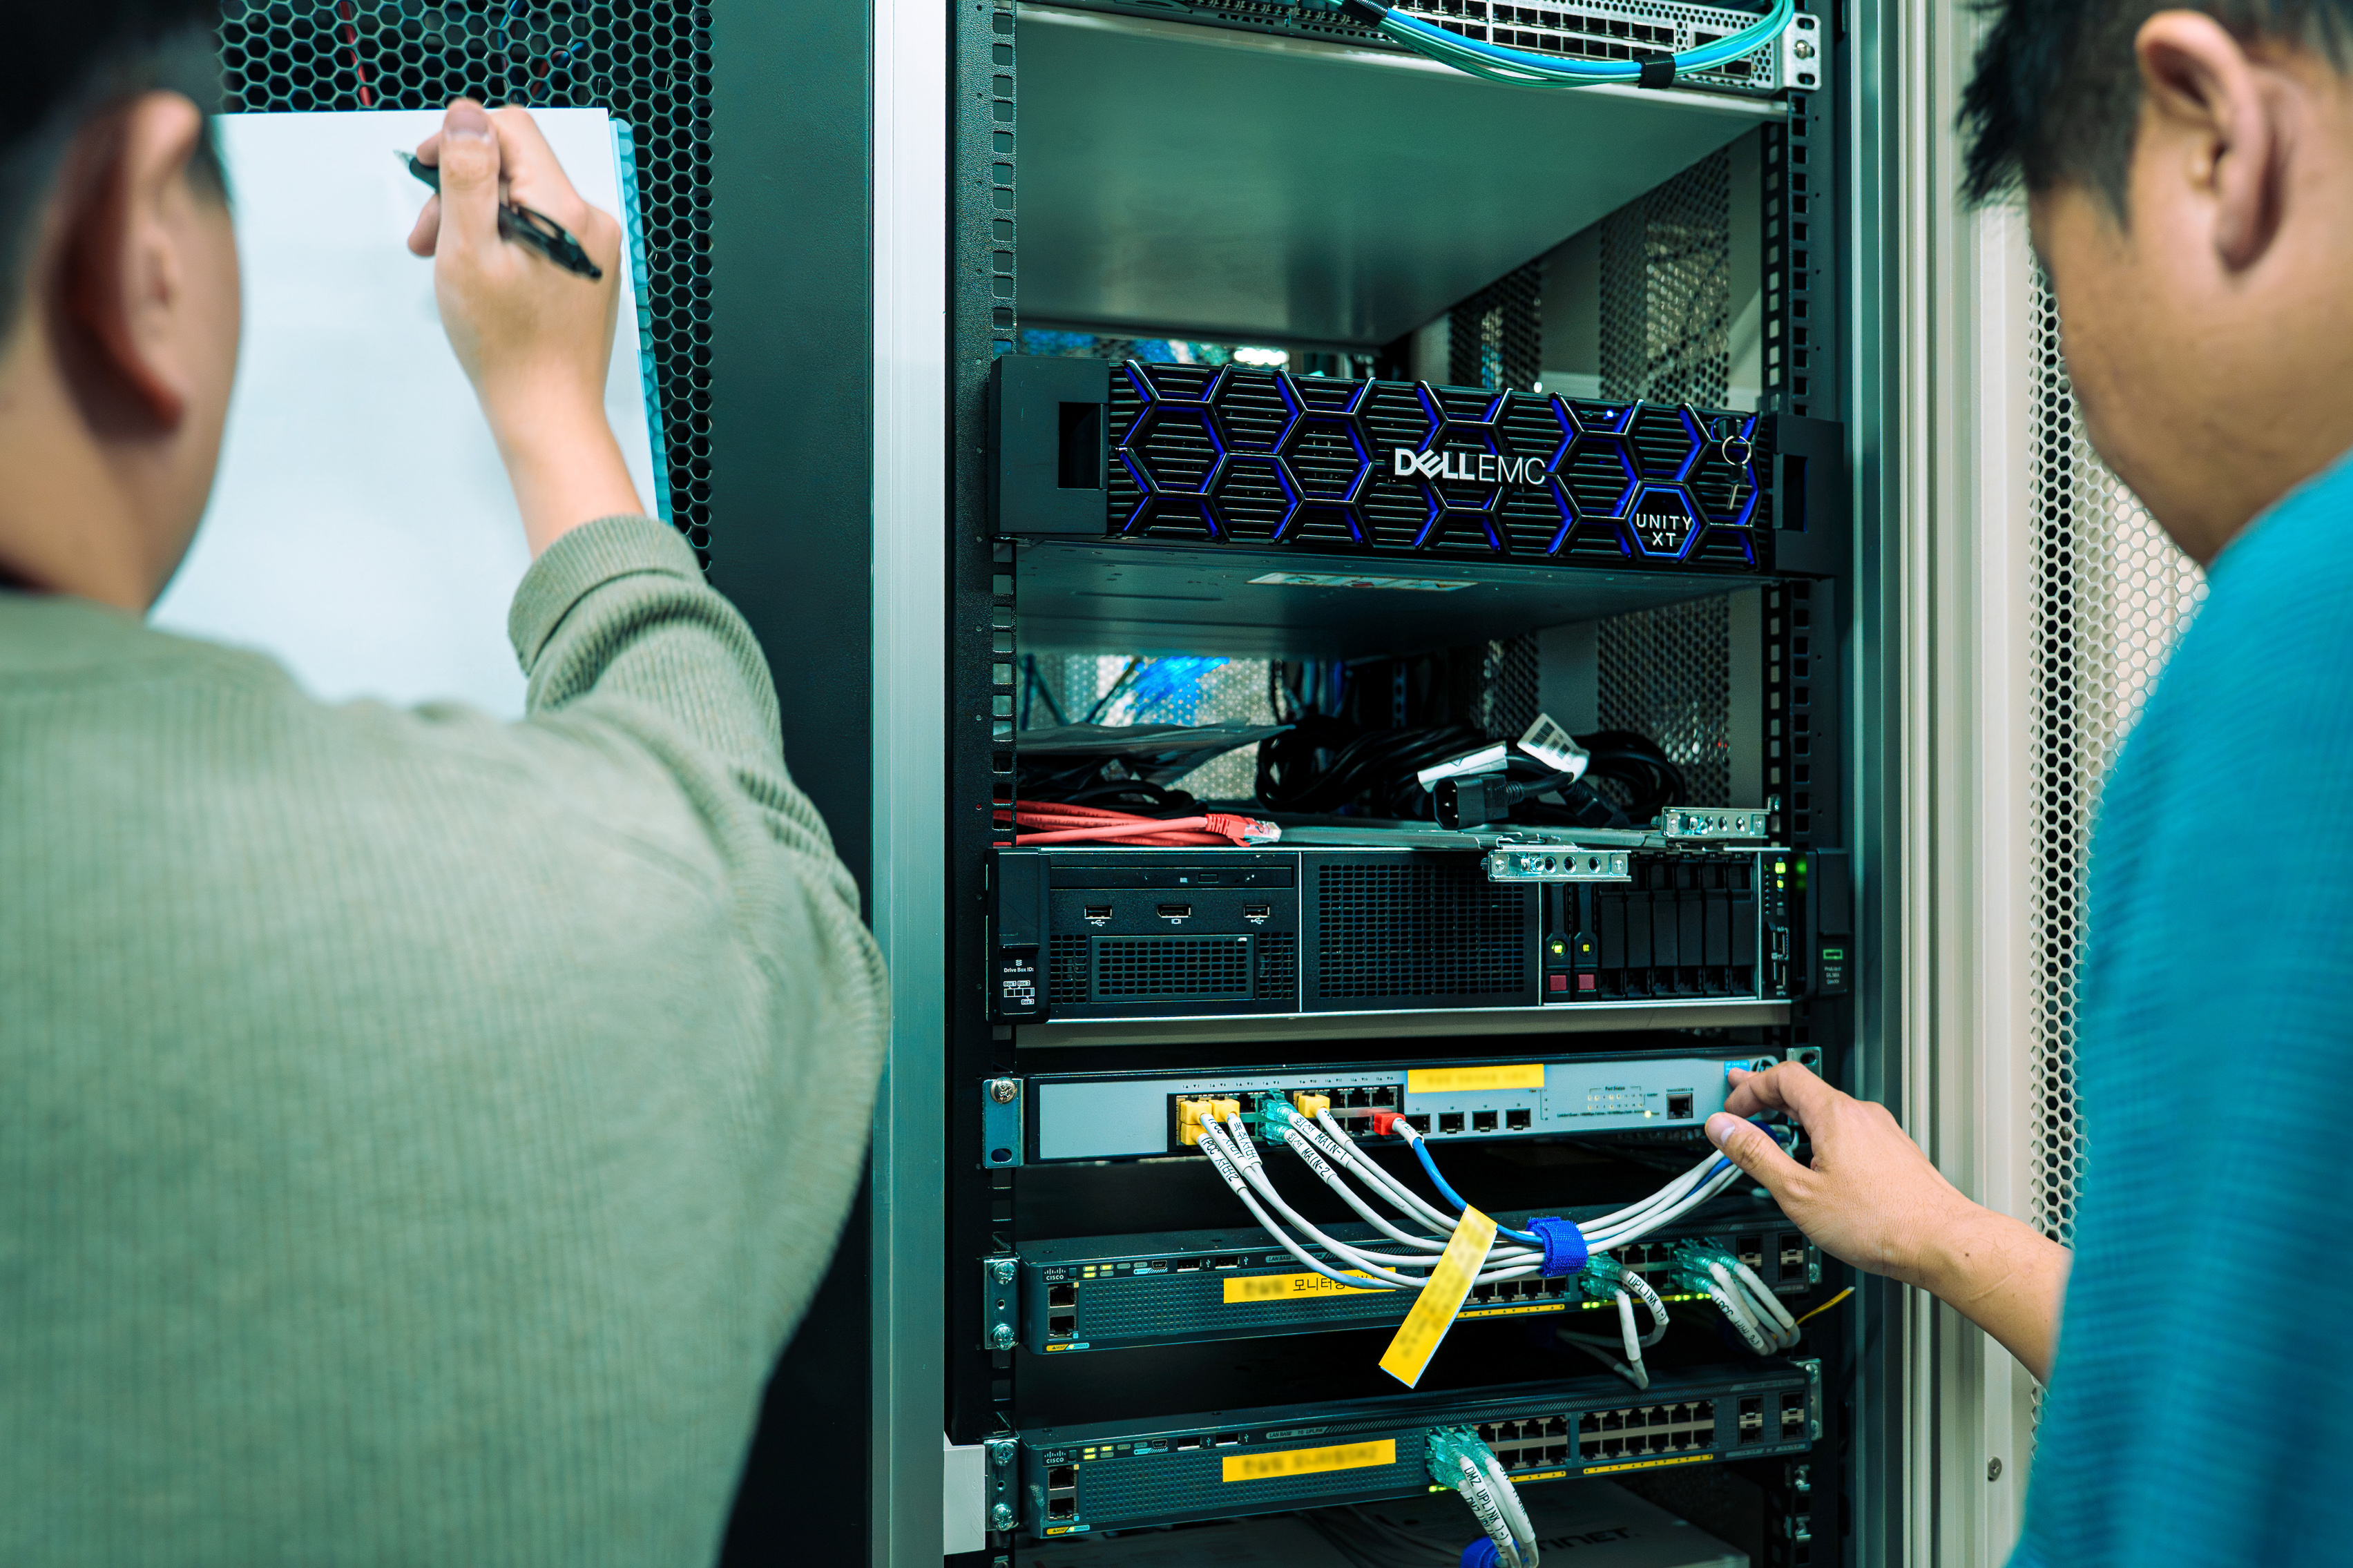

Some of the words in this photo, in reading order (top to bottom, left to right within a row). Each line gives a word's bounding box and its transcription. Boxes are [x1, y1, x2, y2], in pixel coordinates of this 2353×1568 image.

[1636, 512, 1693, 531] UNITY
[1652, 532, 1676, 547] XT
[1201, 1137, 1220, 1154] IPCC
[1215, 1158, 1240, 1182] 서버2
[1287, 1132, 1304, 1150] 회선
[1301, 1148, 1330, 1177] MAIN-2
[1294, 1116, 1315, 1135] 회선
[1315, 1133, 1347, 1160] MAIN-1
[1464, 1467, 1481, 1487] DMZ
[1476, 1489, 1501, 1524] UPLINK
